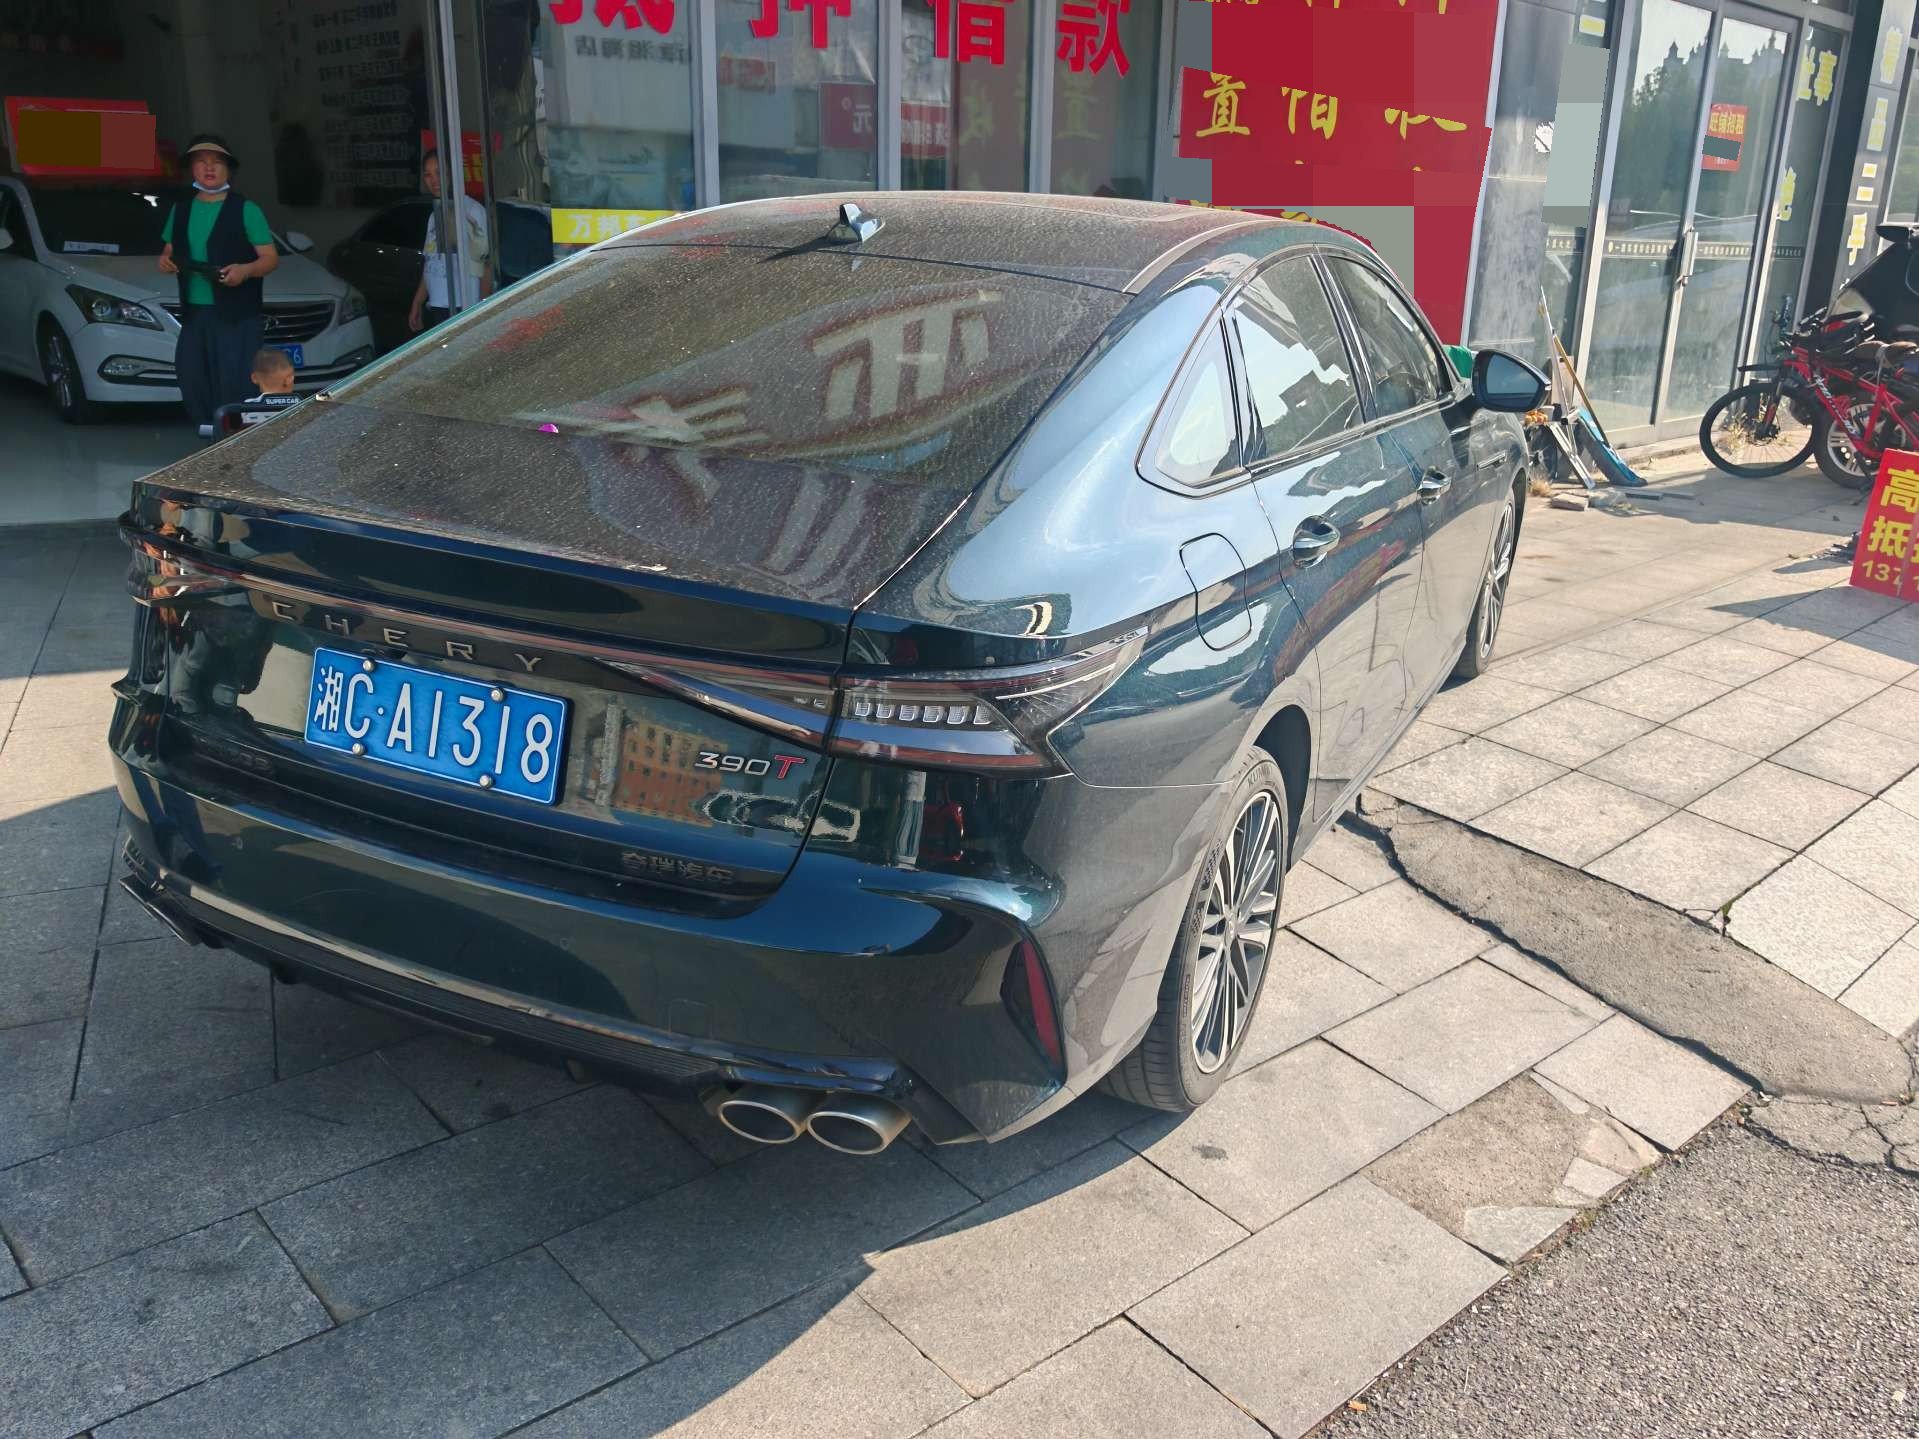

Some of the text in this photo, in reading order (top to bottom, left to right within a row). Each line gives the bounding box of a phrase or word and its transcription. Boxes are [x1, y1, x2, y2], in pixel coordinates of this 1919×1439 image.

[1867, 515, 1919, 564] 抵
[271, 601, 542, 672] CHERY
[694, 751, 806, 780] 390T
[621, 852, 734, 880] 奇瑞汽车
